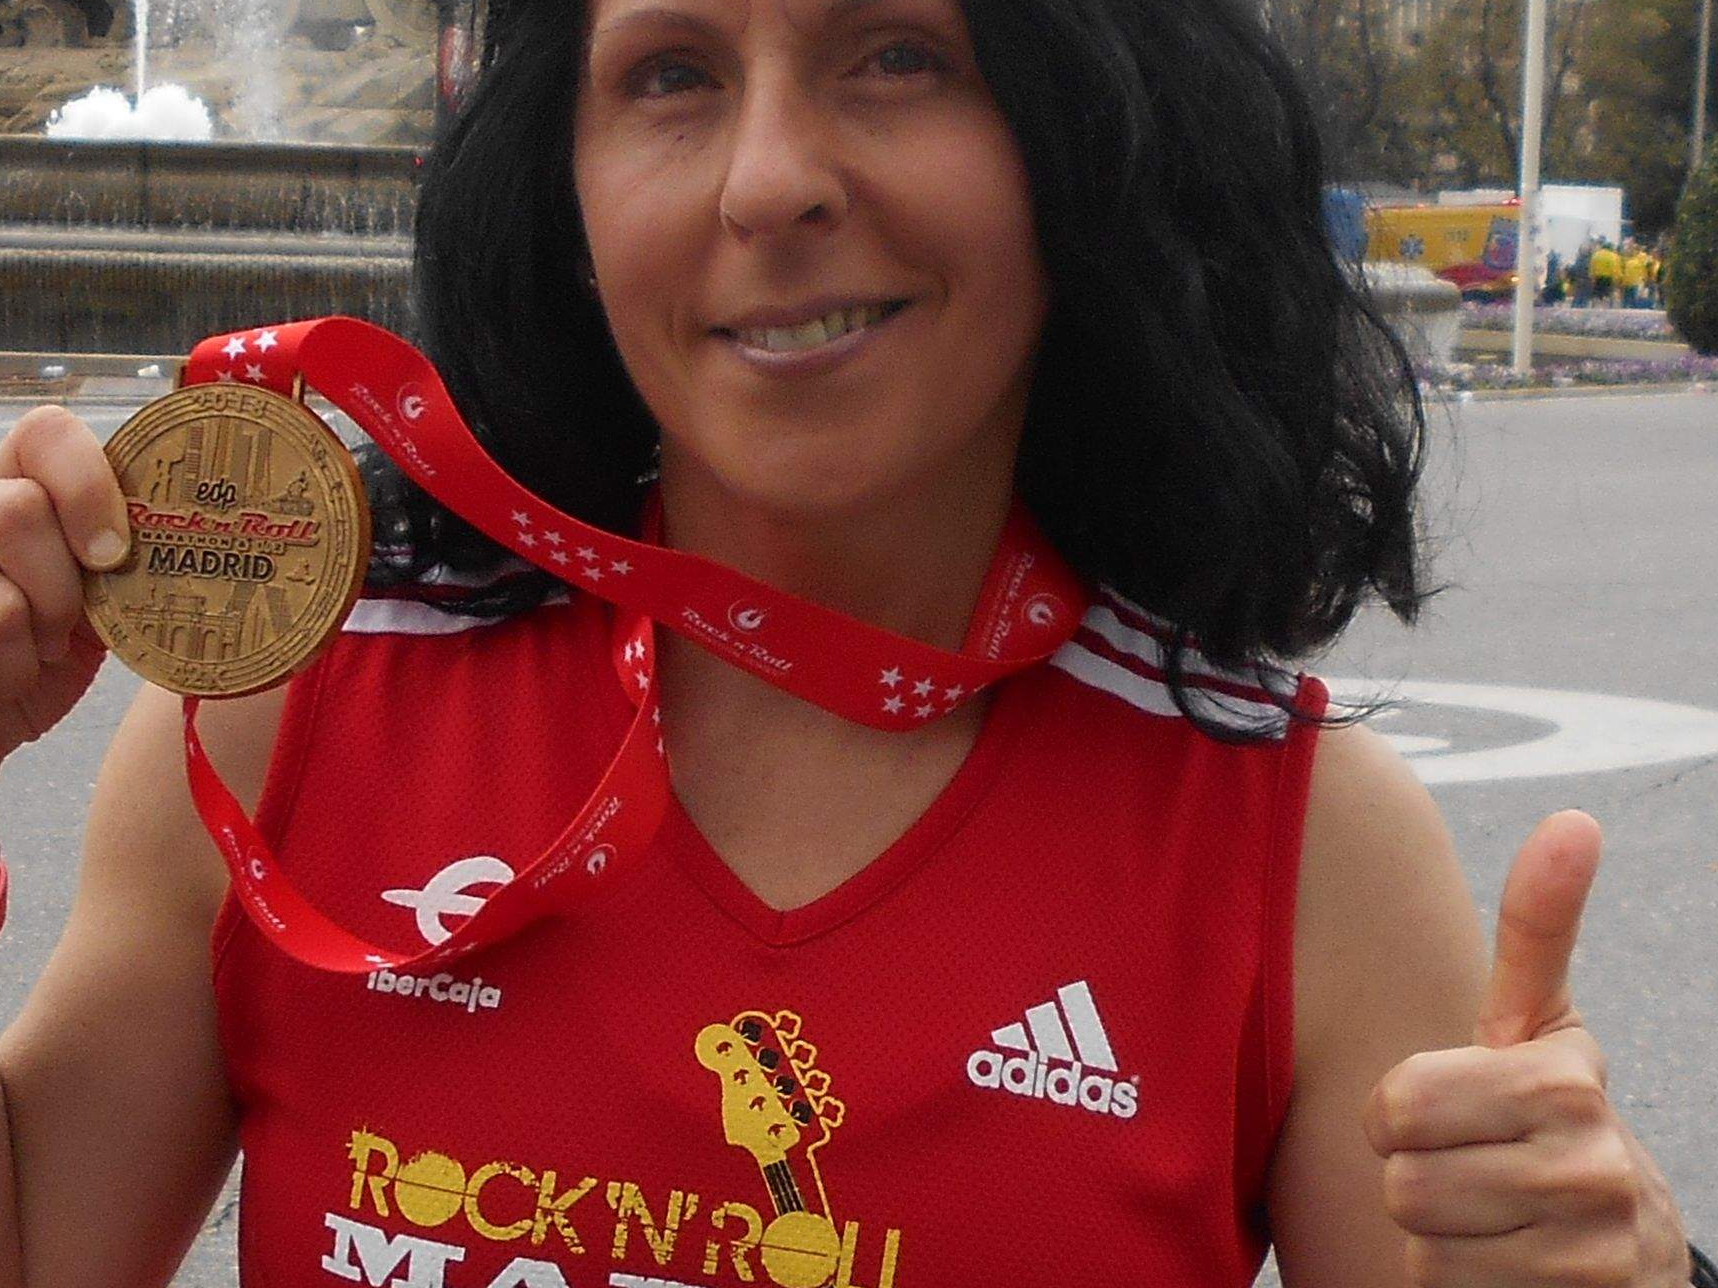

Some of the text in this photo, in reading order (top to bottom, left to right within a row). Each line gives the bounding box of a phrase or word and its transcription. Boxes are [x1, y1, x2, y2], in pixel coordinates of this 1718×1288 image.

[197, 479, 237, 510] edp
[148, 545, 274, 582] MADRID
[967, 1050, 1138, 1118] adidas
